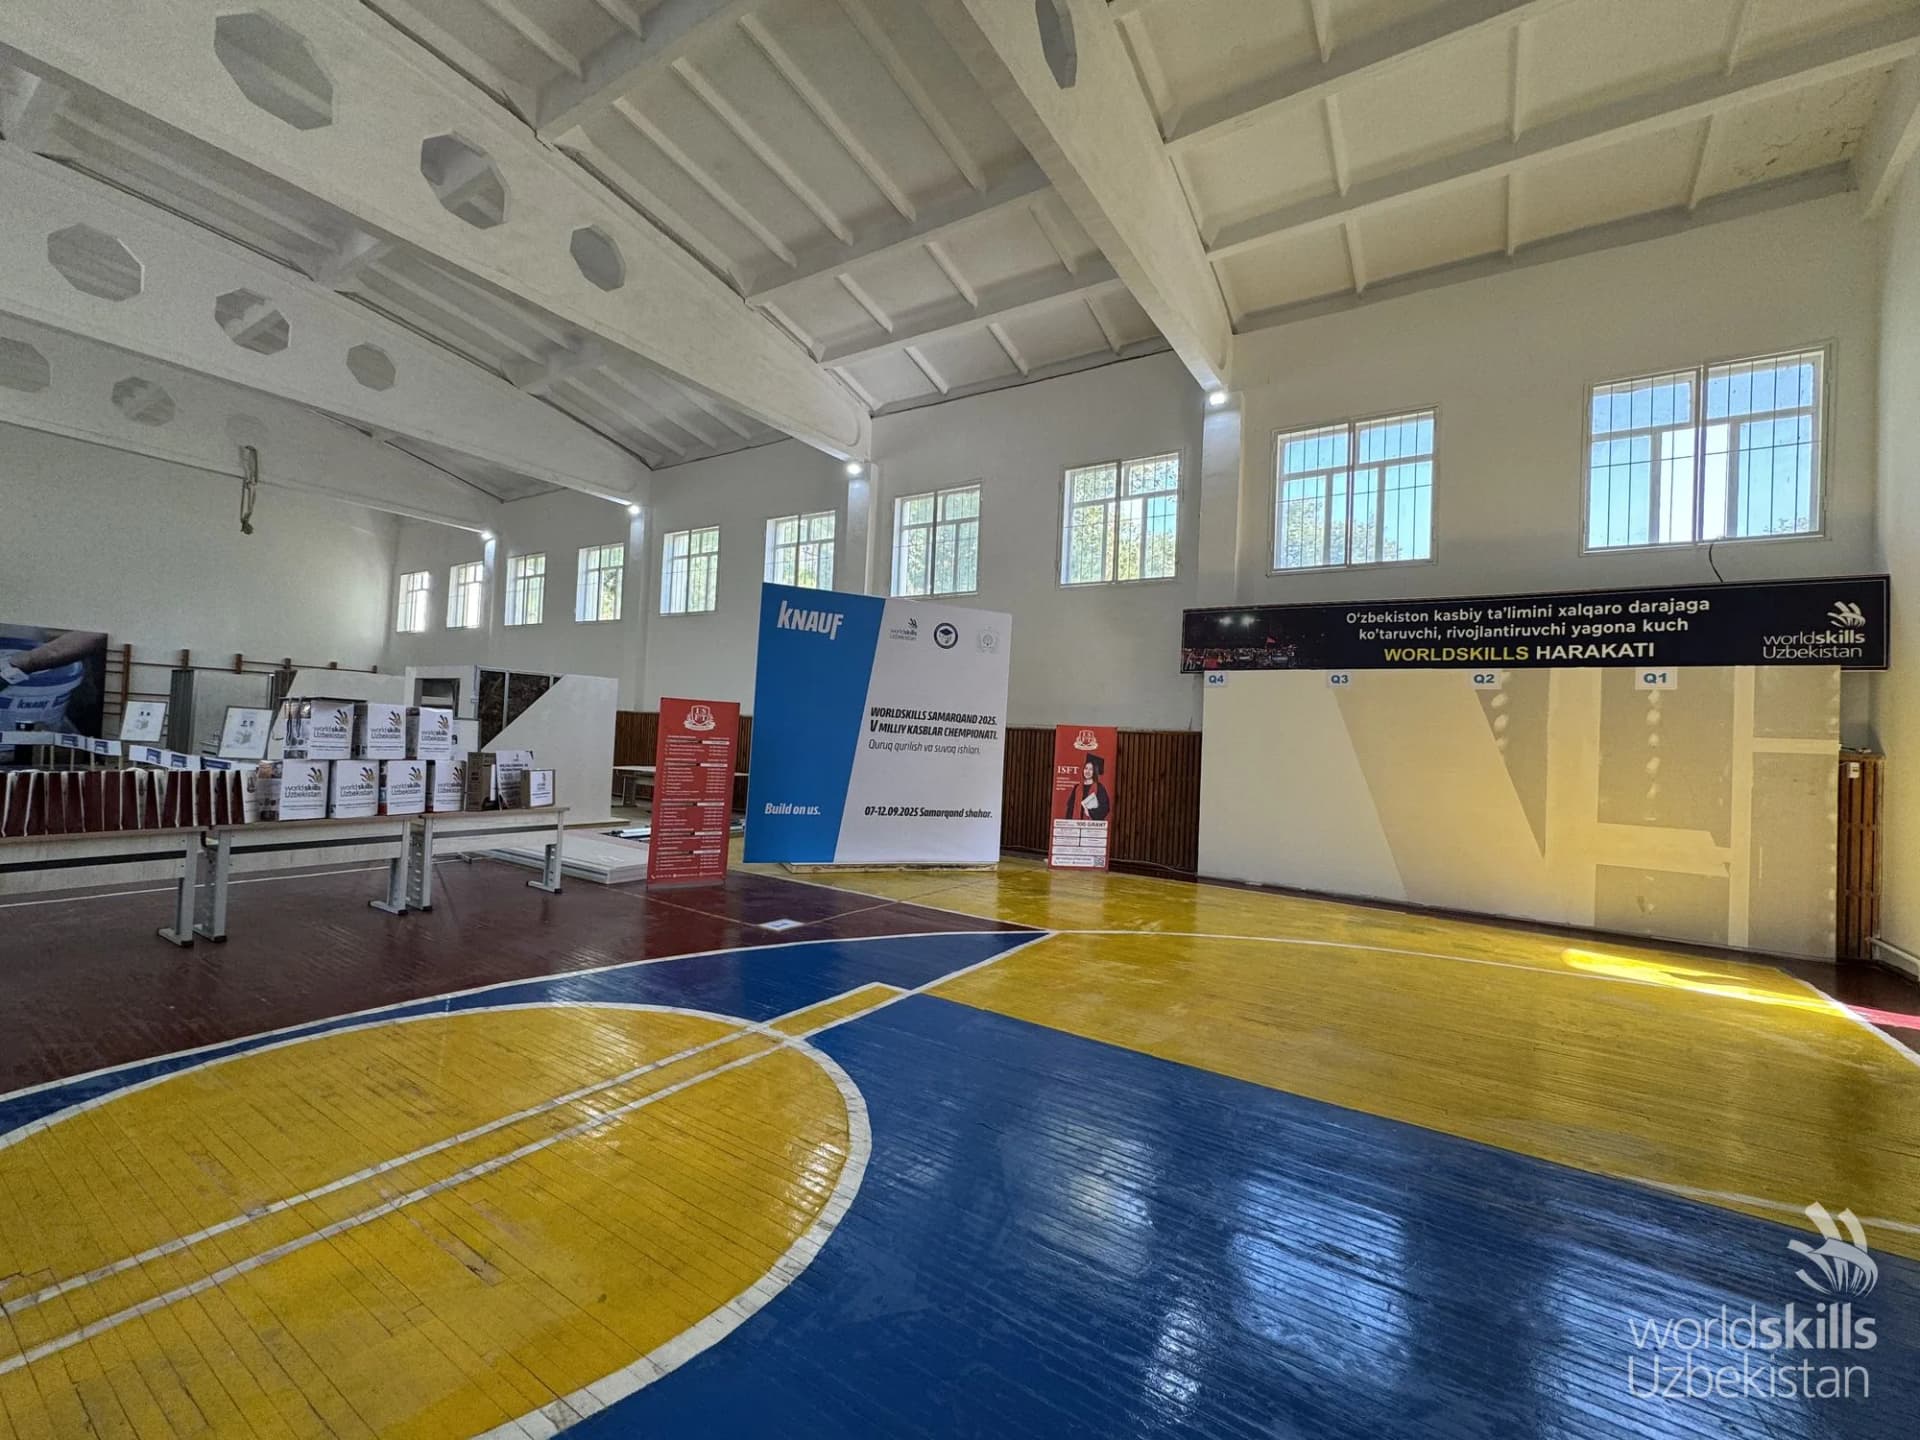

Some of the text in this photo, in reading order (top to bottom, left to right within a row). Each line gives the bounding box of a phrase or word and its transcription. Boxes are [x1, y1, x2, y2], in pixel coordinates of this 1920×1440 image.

[1346, 598, 1710, 624] O‘zbekiston kasbiy ta’limini xalqaro darajaga
[776, 599, 844, 640] KNAUF
[1359, 618, 1688, 641] ko'taruvchi, rivojlantiruvchi yagona kuch
[1763, 630, 1865, 645] worldskills
[1384, 642, 1655, 661] WORLDSKILLS HARAKATI
[1763, 645, 1862, 659] Uzbekistan
[1208, 675, 1224, 684] Q4
[1331, 674, 1349, 684] Q3
[1473, 673, 1495, 684] Q2
[1643, 672, 1667, 684] Q1
[871, 707, 927, 720] WORLDSKILLS
[927, 711, 978, 724] SAMARQAND
[870, 719, 879, 732] V
[878, 723, 907, 734] MILLIY
[907, 725, 943, 736] KASBLAR
[869, 739, 893, 752] Quruq
[1057, 766, 1079, 774] ISFT
[764, 802, 822, 815] Build on us.
[864, 806, 919, 817] 07-12.09.2025
[919, 807, 964, 819] Samarqand
